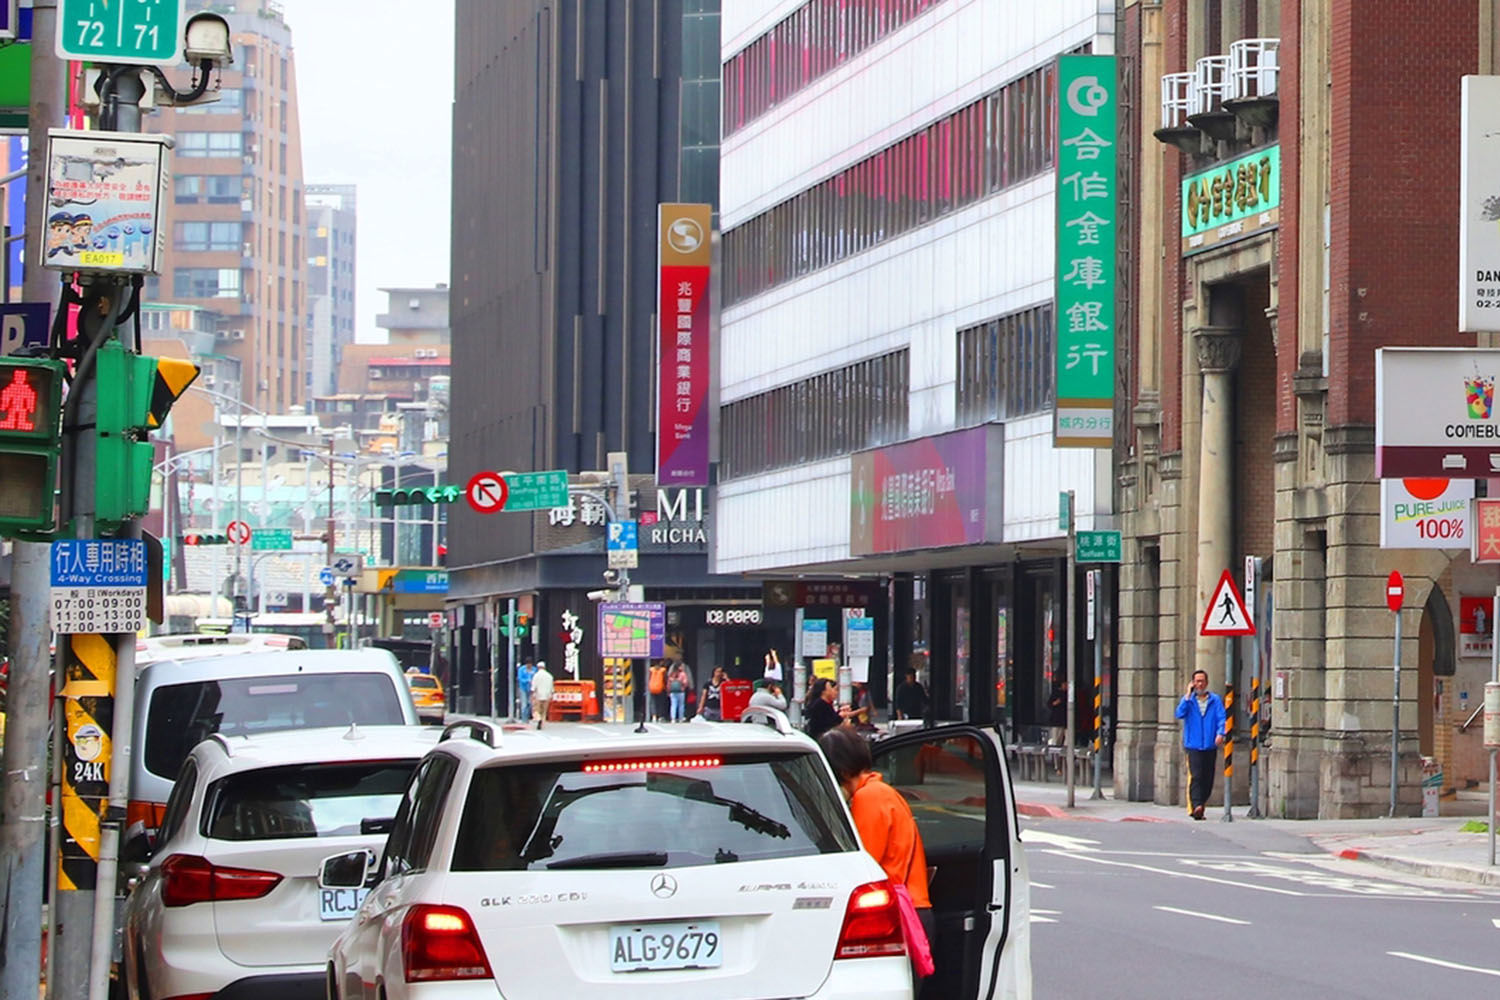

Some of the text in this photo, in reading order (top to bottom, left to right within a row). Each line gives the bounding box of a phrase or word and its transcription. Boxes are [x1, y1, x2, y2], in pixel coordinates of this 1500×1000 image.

[77, 20, 105, 47] 72
[134, 24, 159, 51] 71
[84, 253, 116, 264] EA017
[1063, 127, 1113, 377] 合作金庫銀行
[677, 281, 692, 413] 兆豐國際商業銀行
[1394, 500, 1465, 518] PURE JUICE
[651, 528, 707, 544] RICHA
[1416, 519, 1464, 539] 100%
[1079, 535, 1117, 547] 桃源街
[55, 542, 144, 573] 行人專用時相
[58, 573, 142, 584] 4-Way Crossing
[55, 597, 142, 610] 07:00-09:00
[56, 610, 142, 620] 11:00-13:00
[56, 622, 142, 632] 17:00-19:00
[74, 761, 105, 782] 24K
[613, 932, 719, 963] ALG-9679
